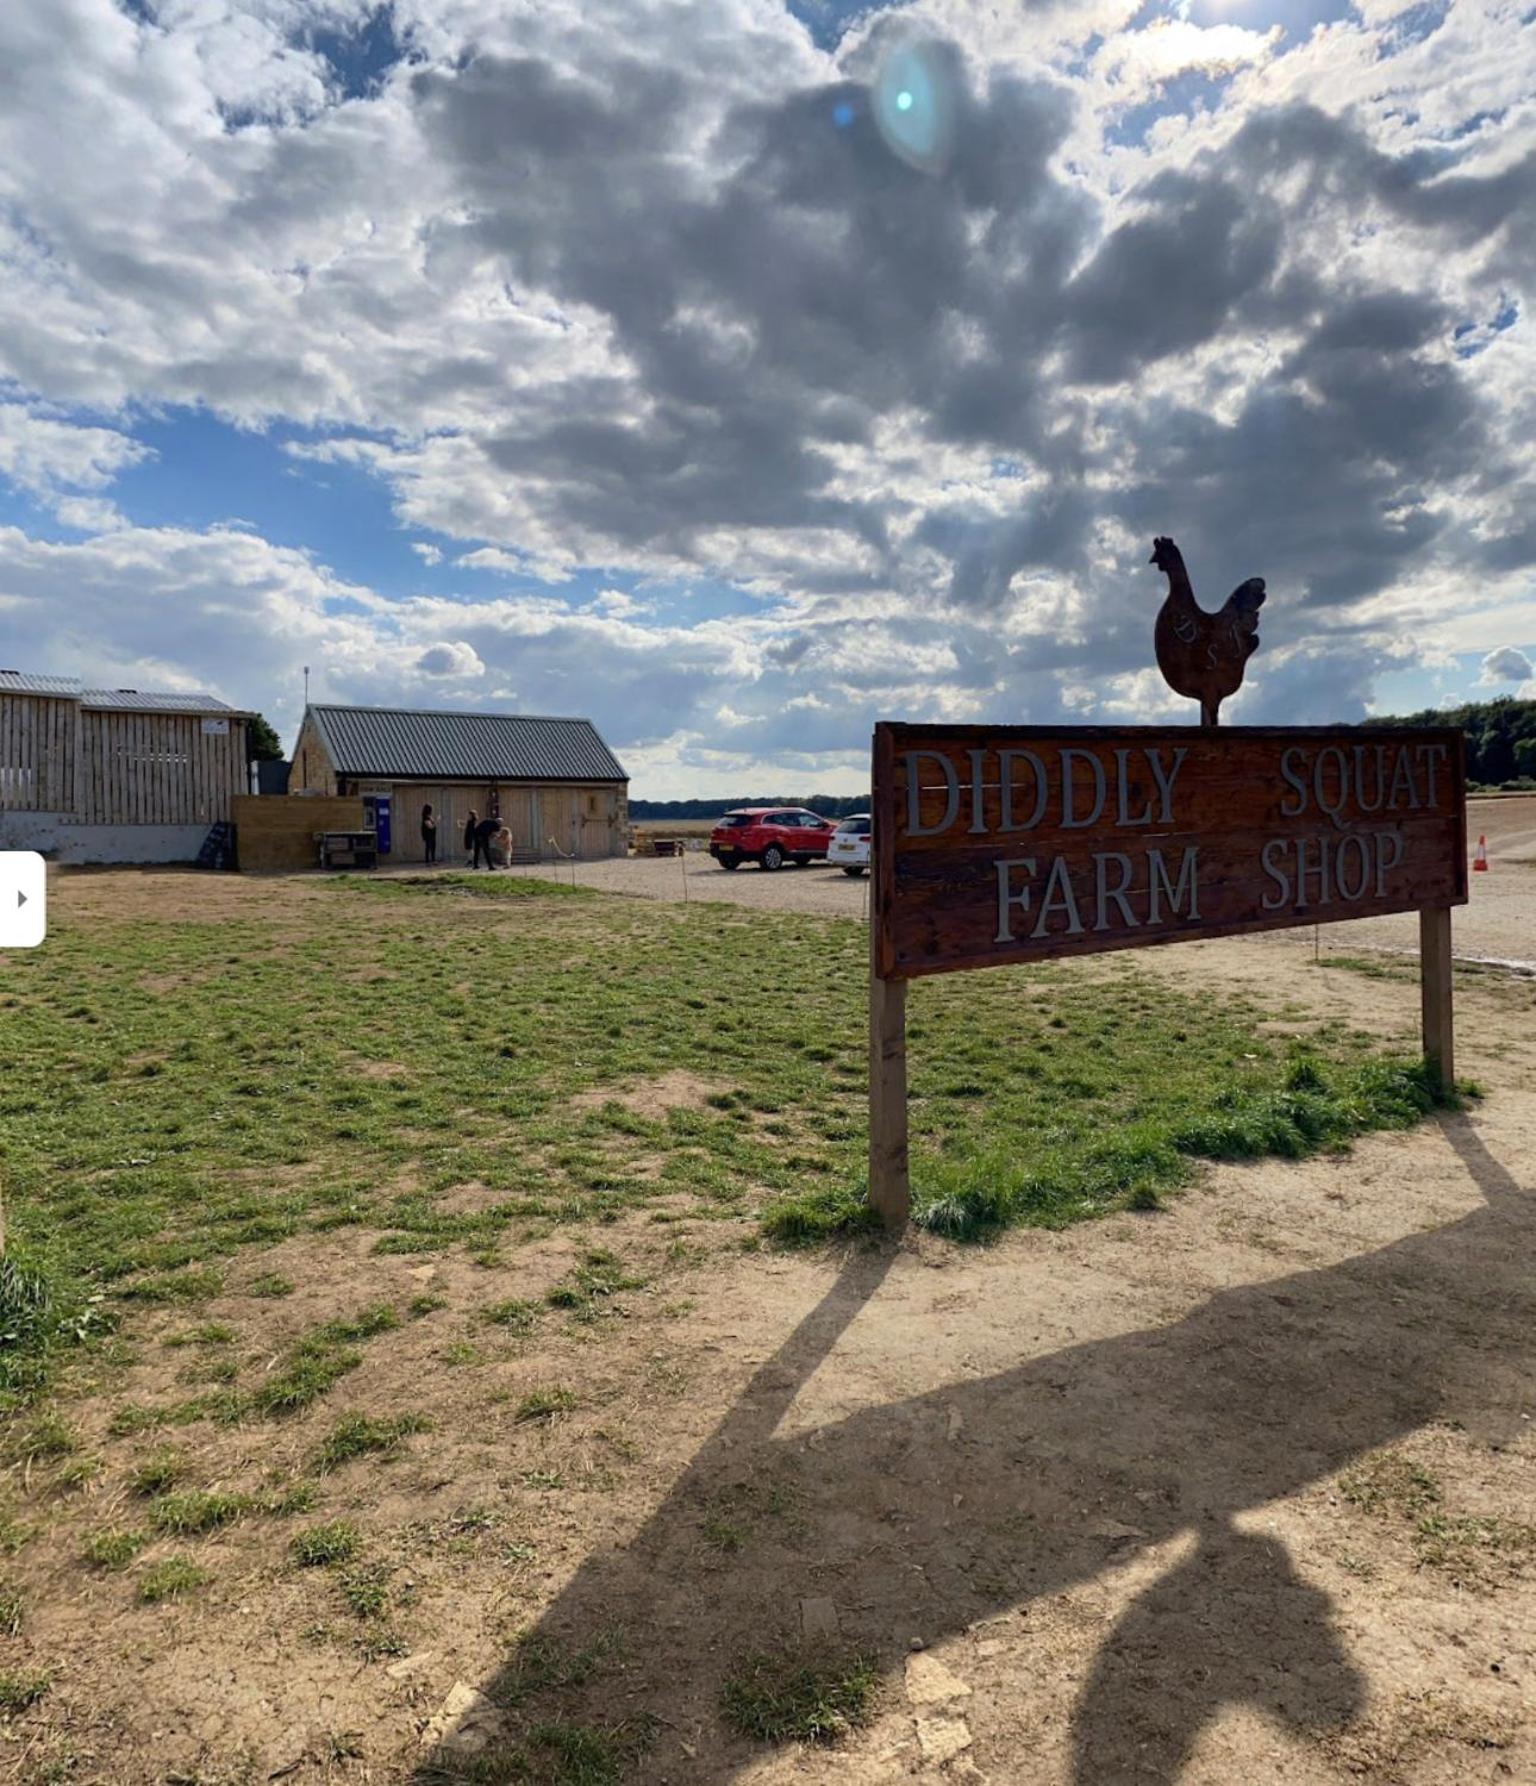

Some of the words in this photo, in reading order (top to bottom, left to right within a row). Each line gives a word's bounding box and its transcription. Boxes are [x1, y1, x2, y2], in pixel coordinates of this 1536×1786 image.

[903, 747, 1189, 837] DIDDLY
[1279, 744, 1447, 830] SQUAT
[993, 847, 1203, 943] FARM
[1261, 830, 1405, 910] SHOP
